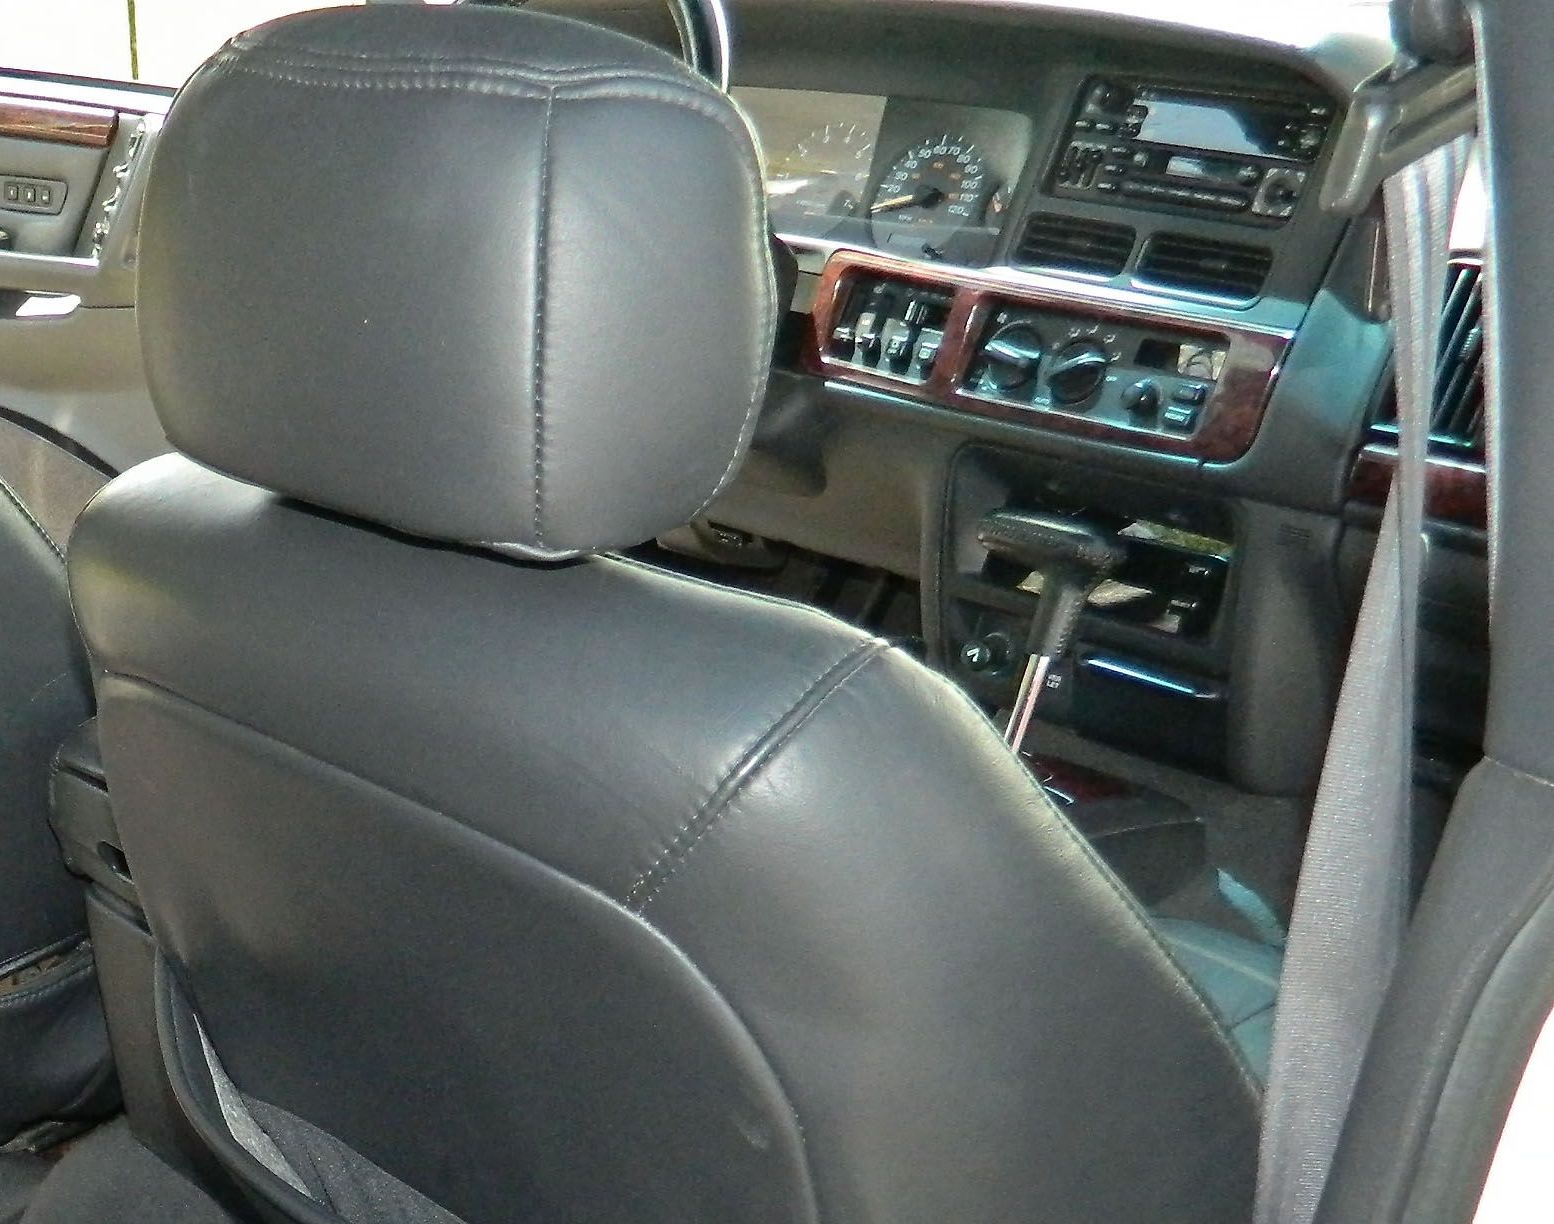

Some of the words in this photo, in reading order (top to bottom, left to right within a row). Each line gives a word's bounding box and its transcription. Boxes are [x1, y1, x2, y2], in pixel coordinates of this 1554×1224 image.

[933, 145, 947, 155] 60
[948, 146, 961, 156] 70
[960, 180, 978, 189] 100
